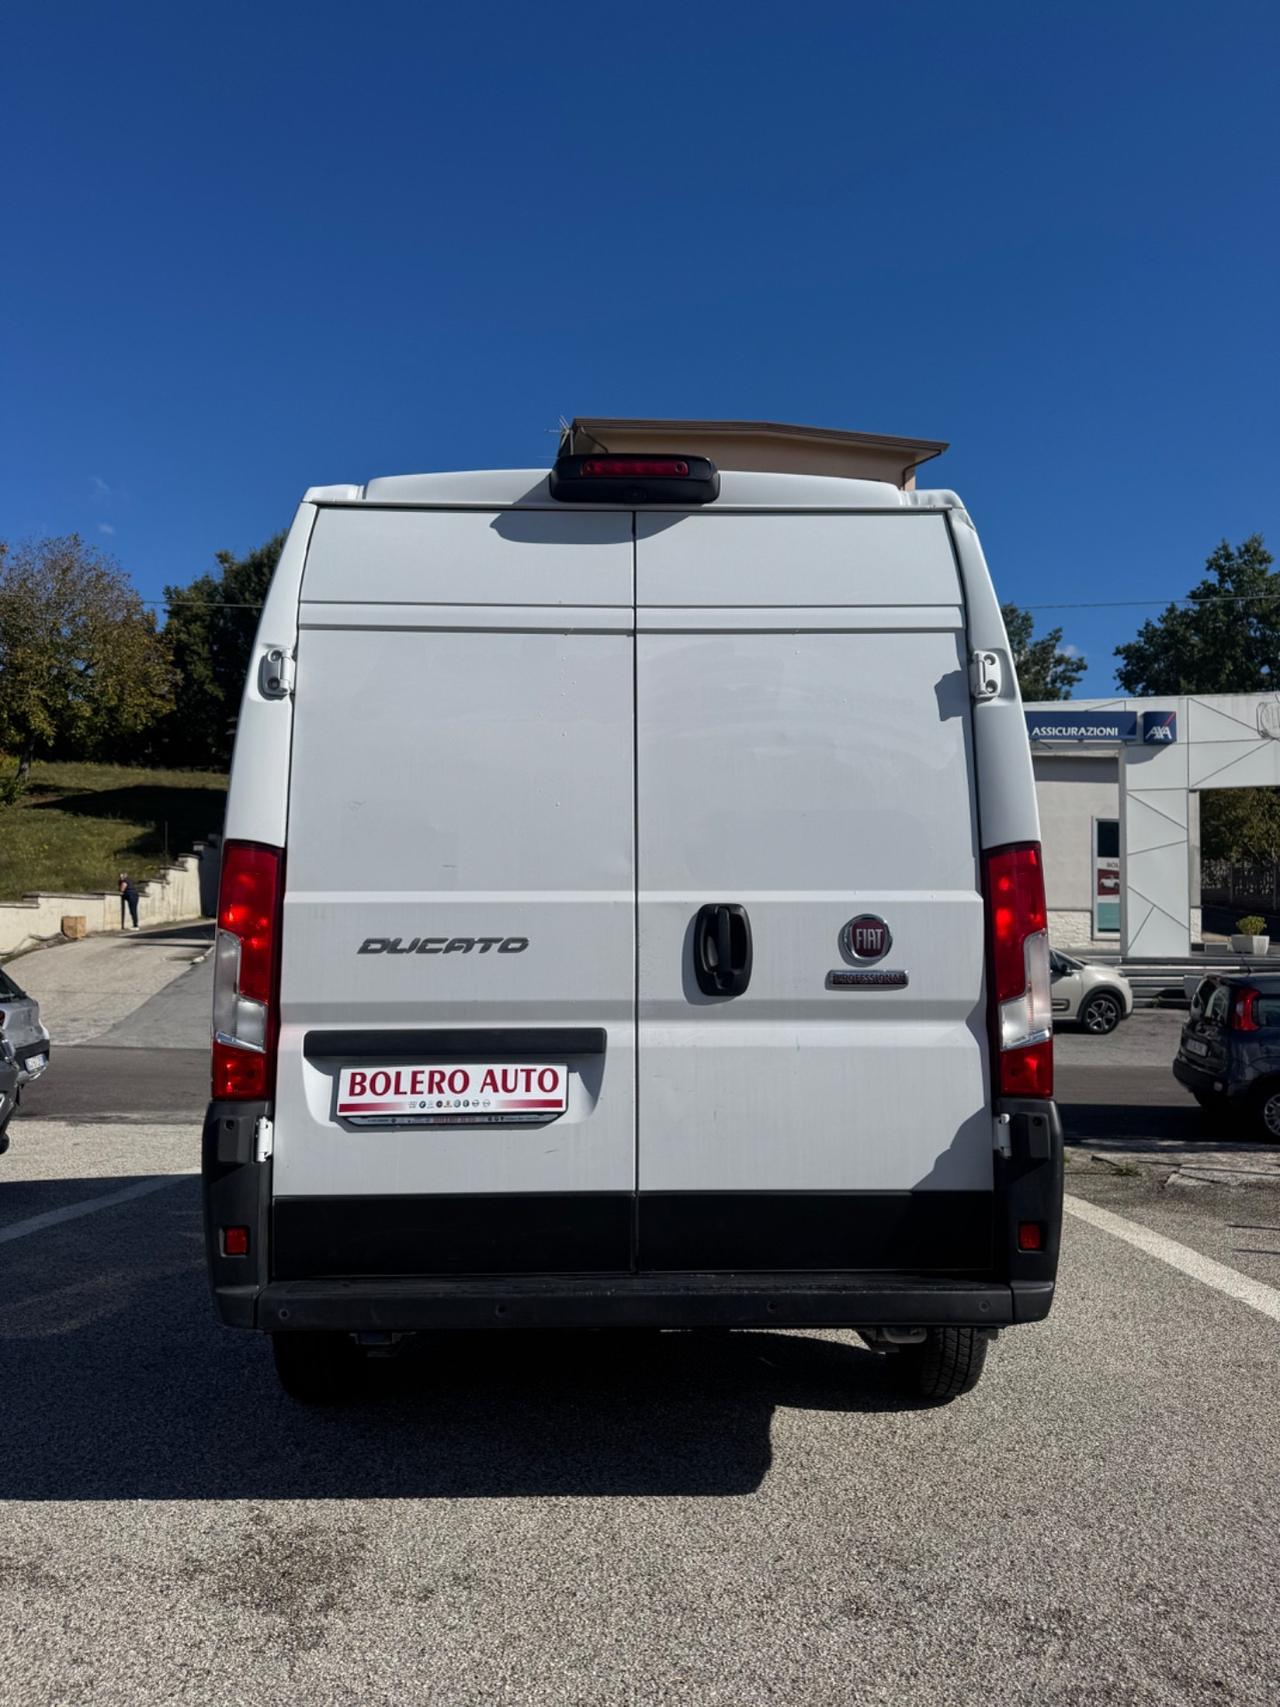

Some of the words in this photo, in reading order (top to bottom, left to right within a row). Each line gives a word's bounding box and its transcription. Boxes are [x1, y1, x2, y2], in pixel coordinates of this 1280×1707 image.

[1032, 726, 1119, 737] ASSICURAZIONI
[1145, 726, 1173, 740] AXA
[357, 937, 530, 954] DUCATO
[856, 928, 884, 950] FIAT
[348, 1068, 470, 1097] BOLERO
[480, 1067, 559, 1094] AUTO
